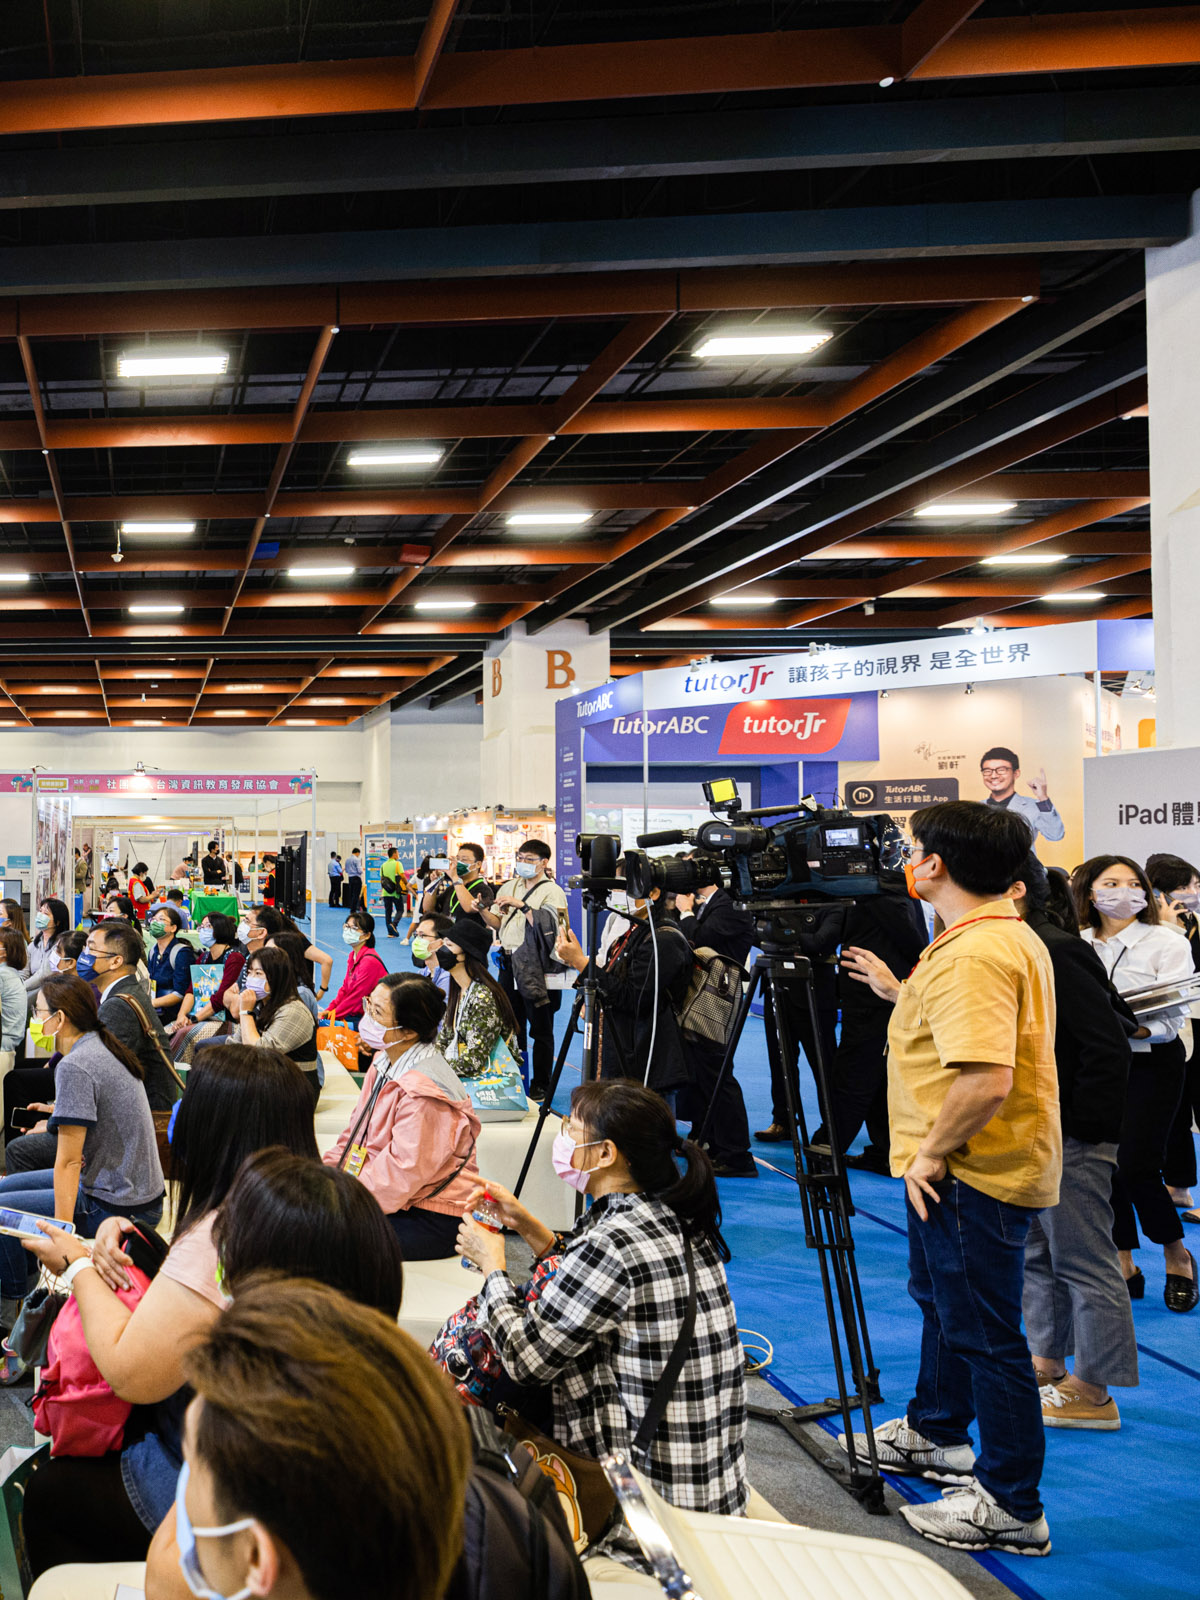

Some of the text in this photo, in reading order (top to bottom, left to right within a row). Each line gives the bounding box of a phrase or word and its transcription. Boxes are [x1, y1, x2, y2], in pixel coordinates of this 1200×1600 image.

[491, 658, 502, 698] B
[545, 650, 576, 690] B
[684, 642, 1031, 694] tutorJr 讓孩子的視界 是全世界
[576, 690, 614, 719] TutorABC
[611, 712, 826, 740] TutorABC tutorJr
[106, 779, 279, 790] 社團台灣資訊教育發展協會
[884, 784, 927, 794] TutorABC
[1118, 801, 1200, 826] iPad 體
